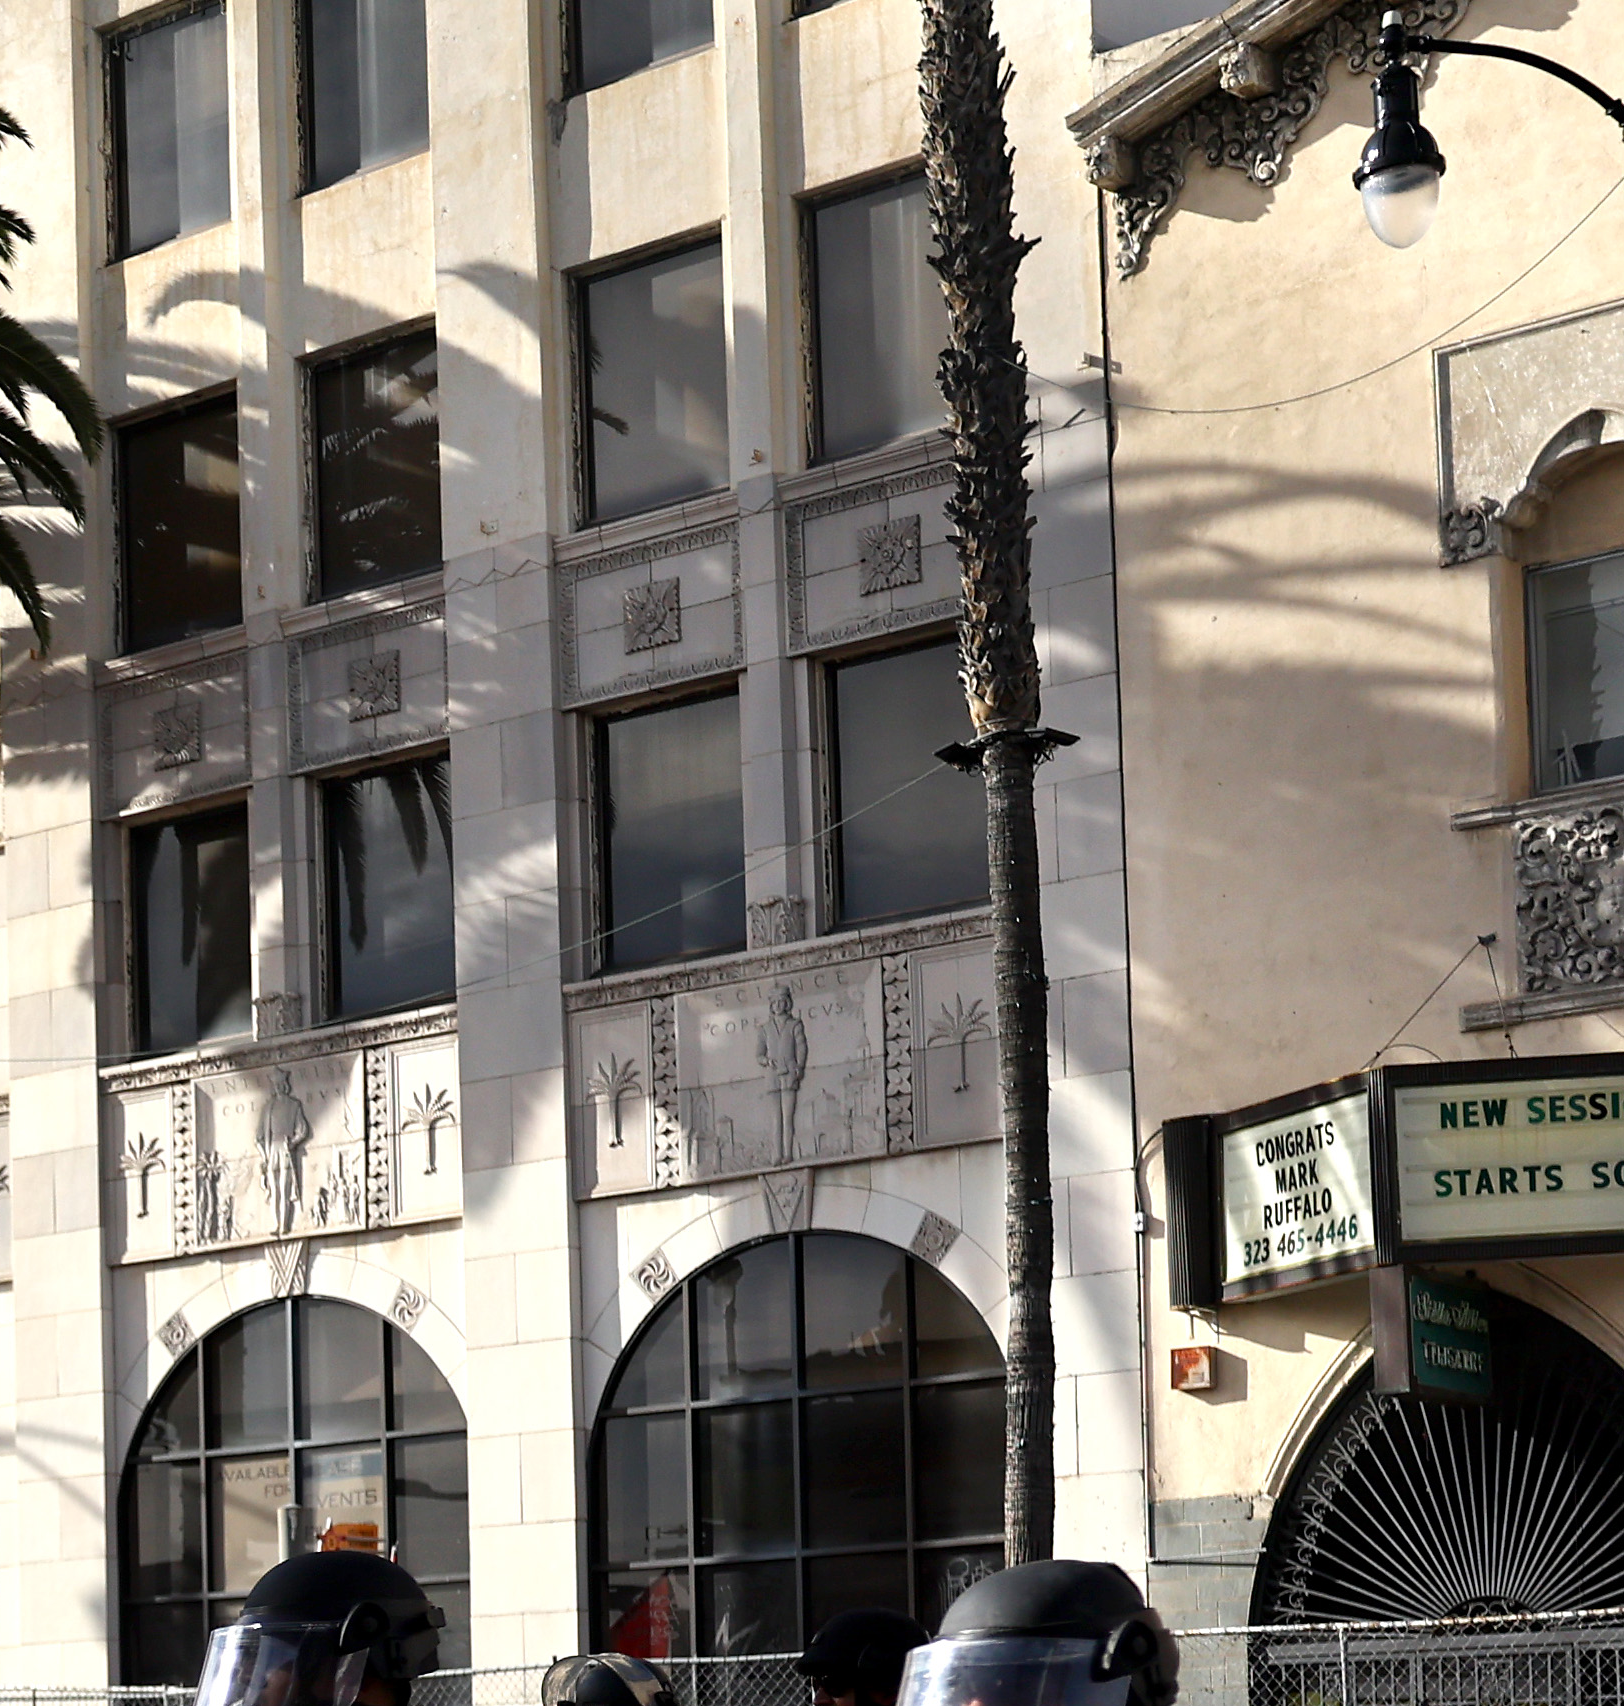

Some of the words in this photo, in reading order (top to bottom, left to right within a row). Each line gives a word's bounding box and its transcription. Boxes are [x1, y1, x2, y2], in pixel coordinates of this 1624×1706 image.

[1439, 1098, 1508, 1130] NEW
[1527, 1091, 1624, 1125] SESSI
[1255, 1120, 1335, 1168] CONGRATS
[1275, 1158, 1320, 1195] MARK
[1433, 1164, 1564, 1198] STARTS
[1263, 1187, 1333, 1230] RUFFALO
[1243, 1237, 1271, 1267] 323
[1276, 1213, 1358, 1258] 465-4446
